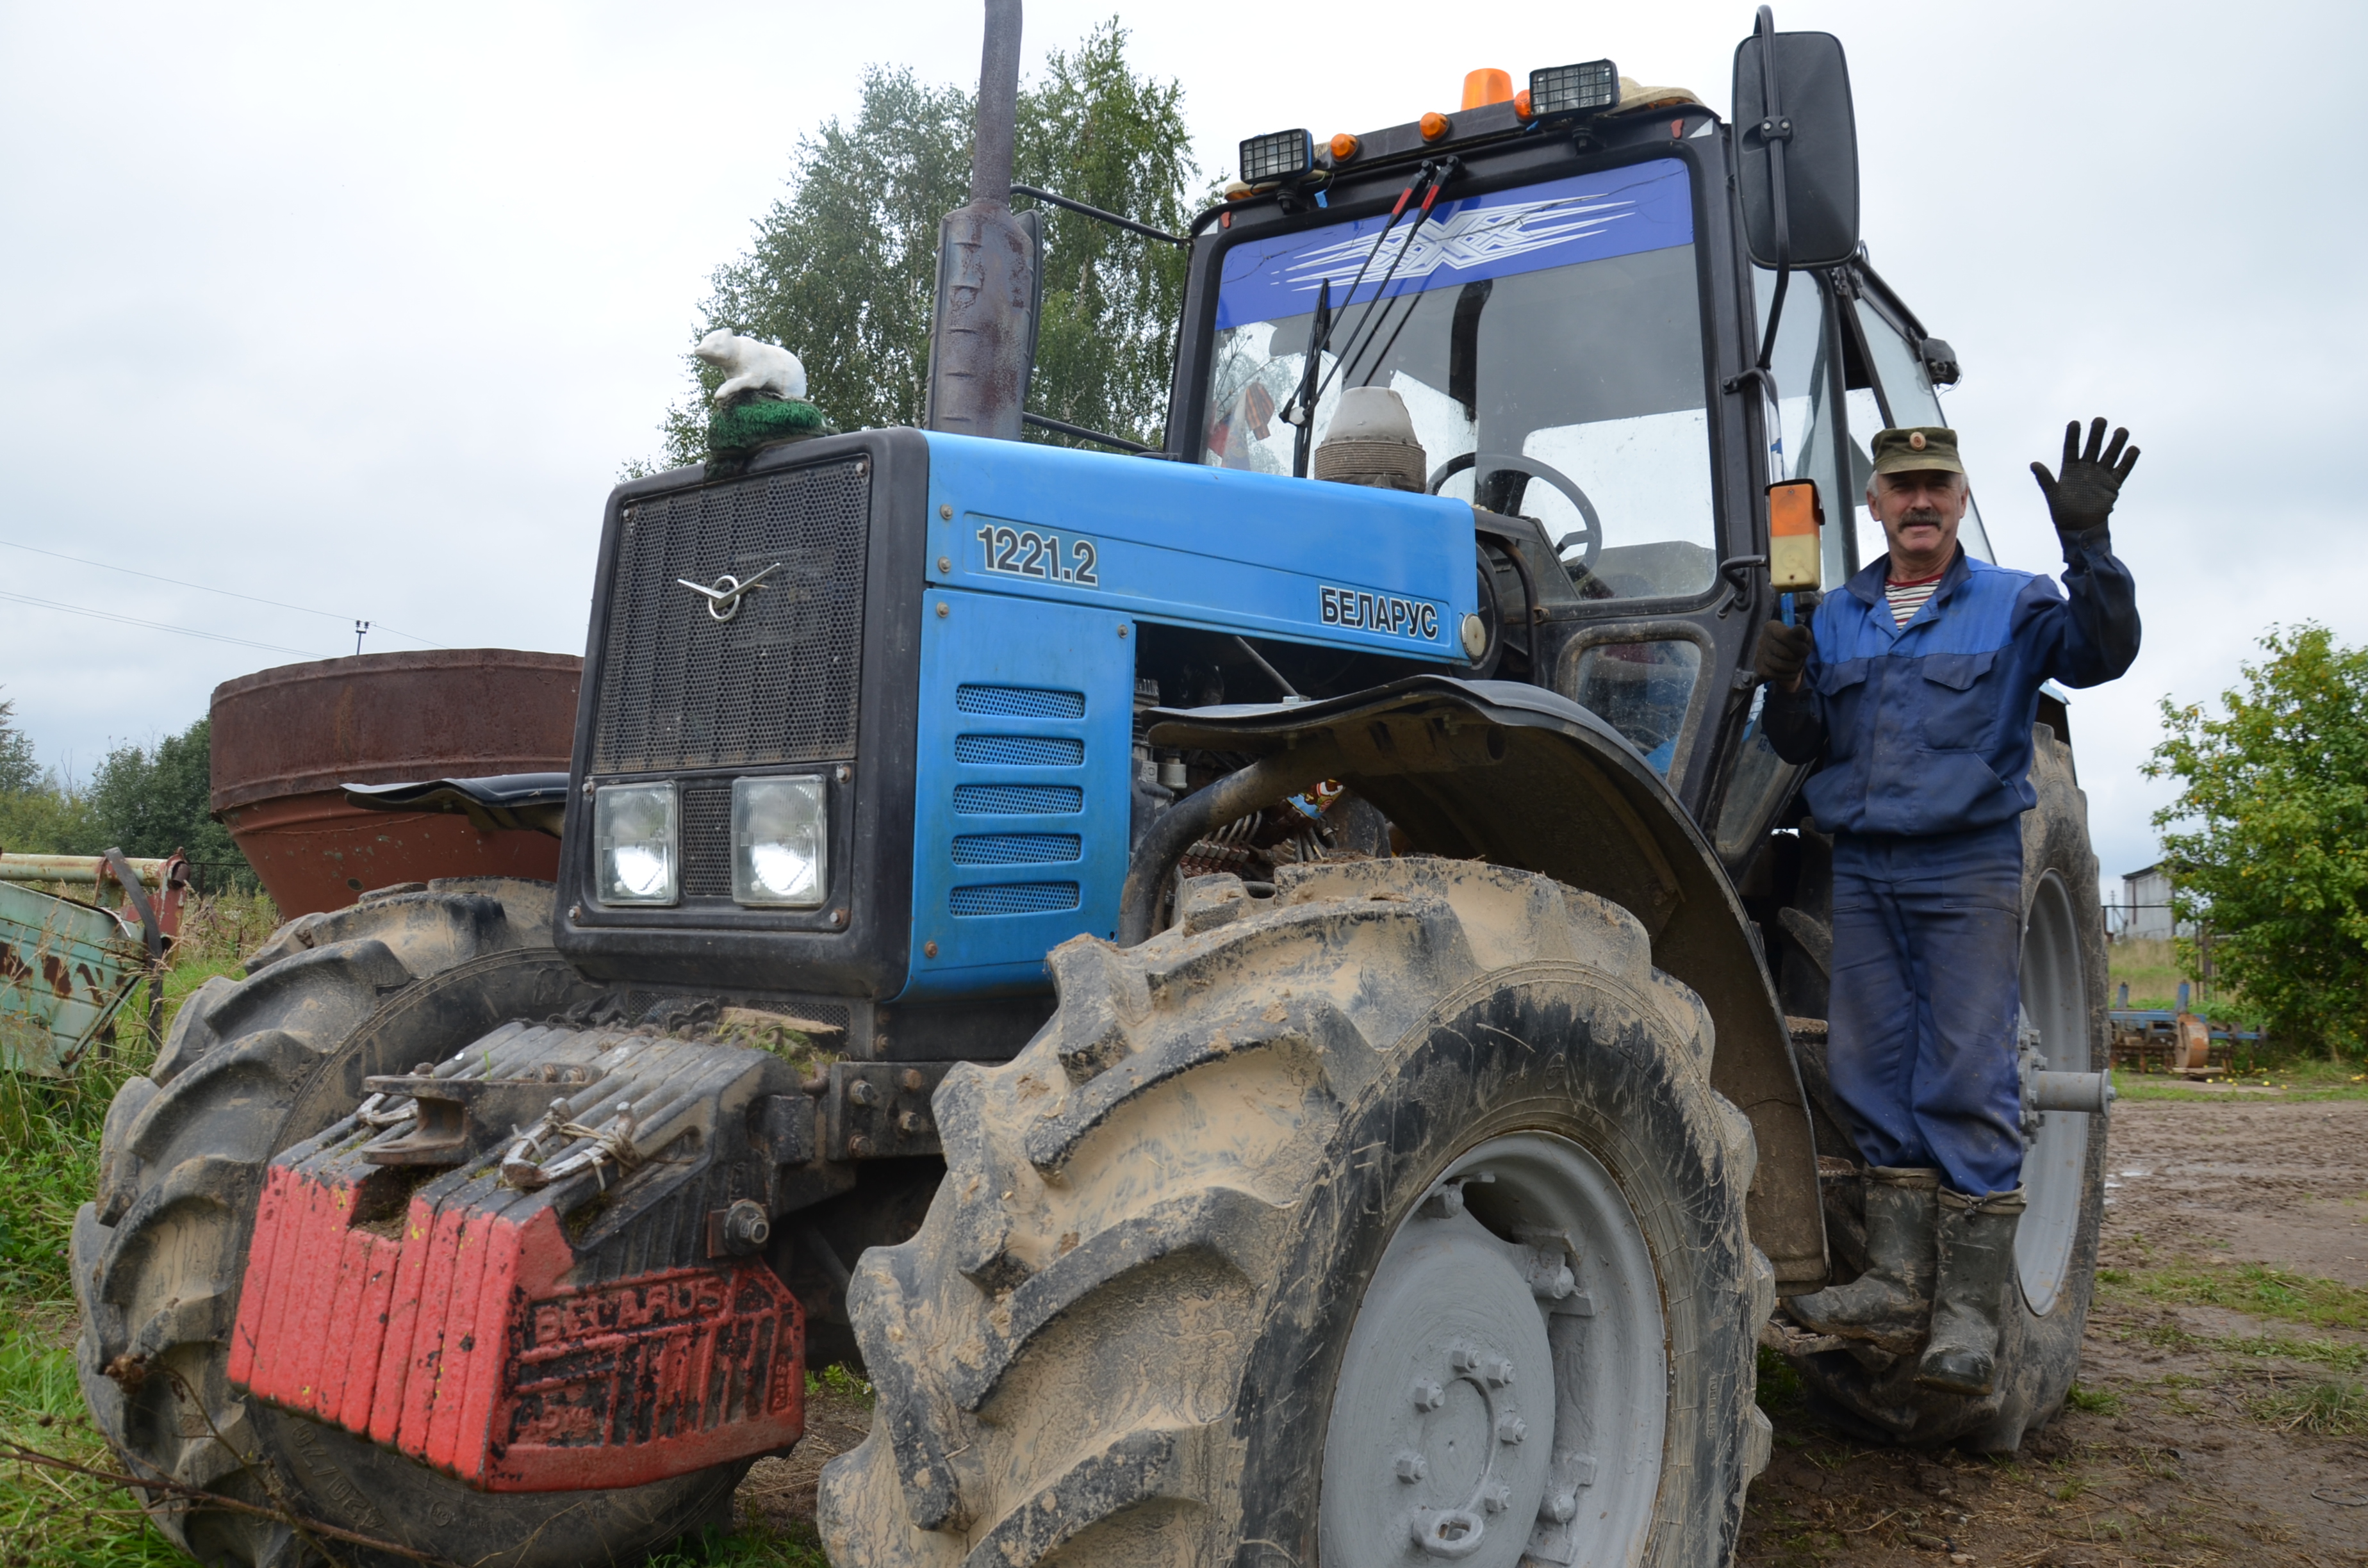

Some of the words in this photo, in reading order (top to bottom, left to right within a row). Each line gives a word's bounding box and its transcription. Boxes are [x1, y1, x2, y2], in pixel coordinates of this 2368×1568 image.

[976, 524, 1098, 587] 1221.2
[1320, 585, 1438, 640] БЕЛАРУС
[535, 1277, 725, 1343] BELARUS
